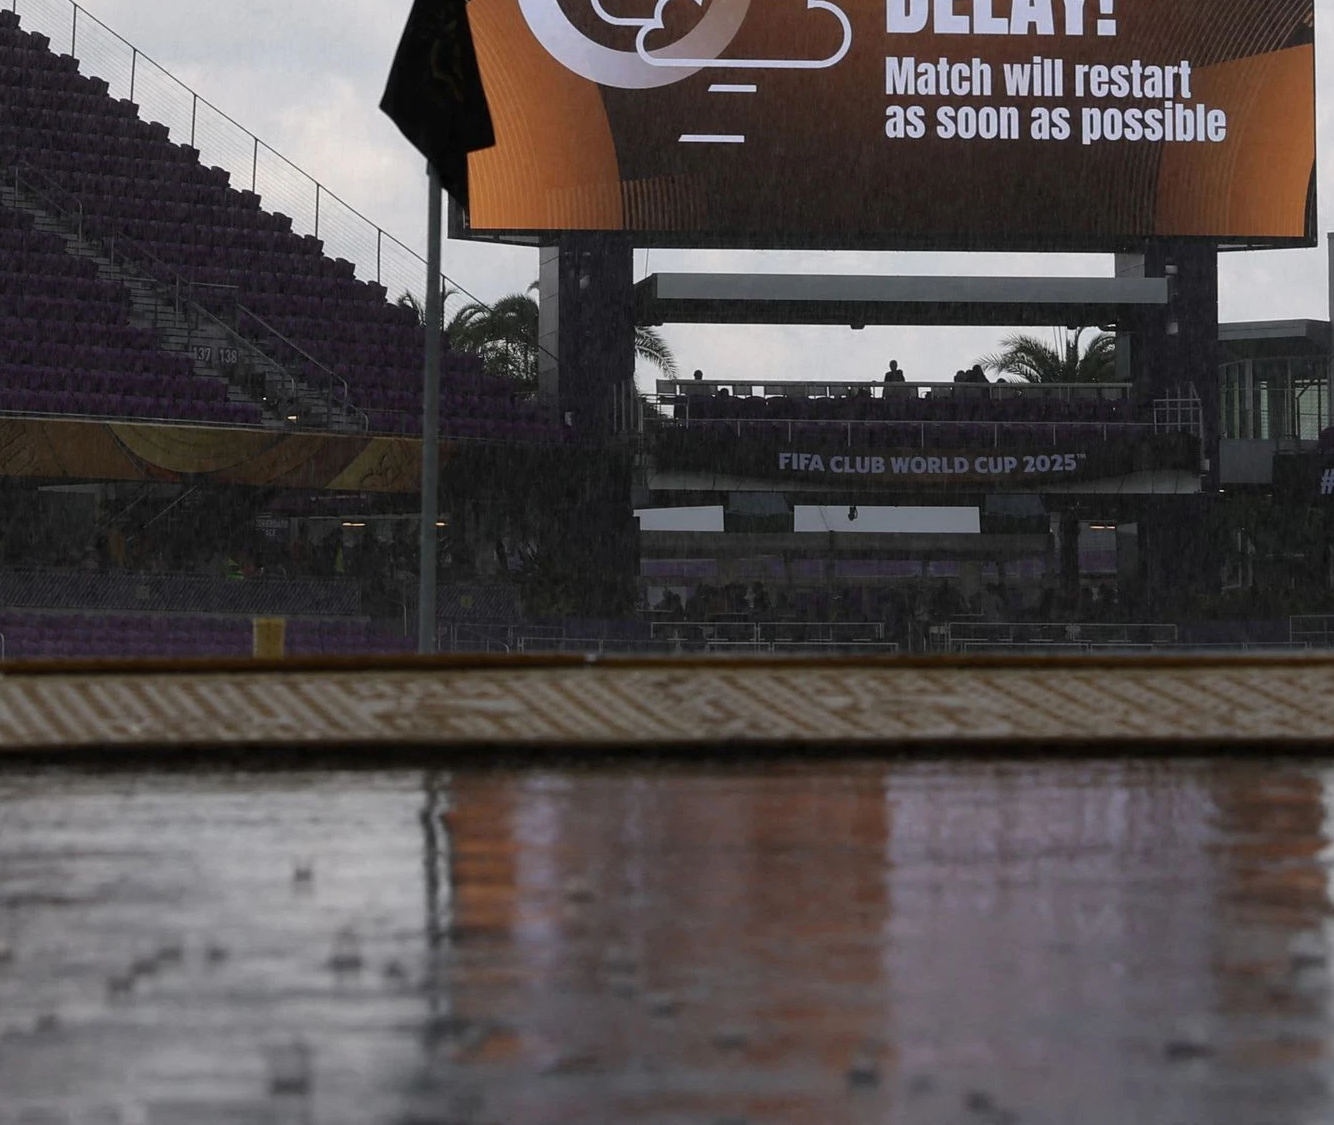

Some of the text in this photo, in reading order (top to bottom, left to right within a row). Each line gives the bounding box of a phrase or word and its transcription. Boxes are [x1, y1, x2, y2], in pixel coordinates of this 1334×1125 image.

[885, 55, 1192, 99] Match will restart
[885, 101, 1227, 145] as soon as possible
[193, 346, 211, 361] 137
[219, 348, 238, 363] 138
[778, 452, 825, 471] FIFA
[829, 455, 885, 473] CLUB
[889, 456, 970, 474] WORLD
[974, 456, 1017, 473] CUP
